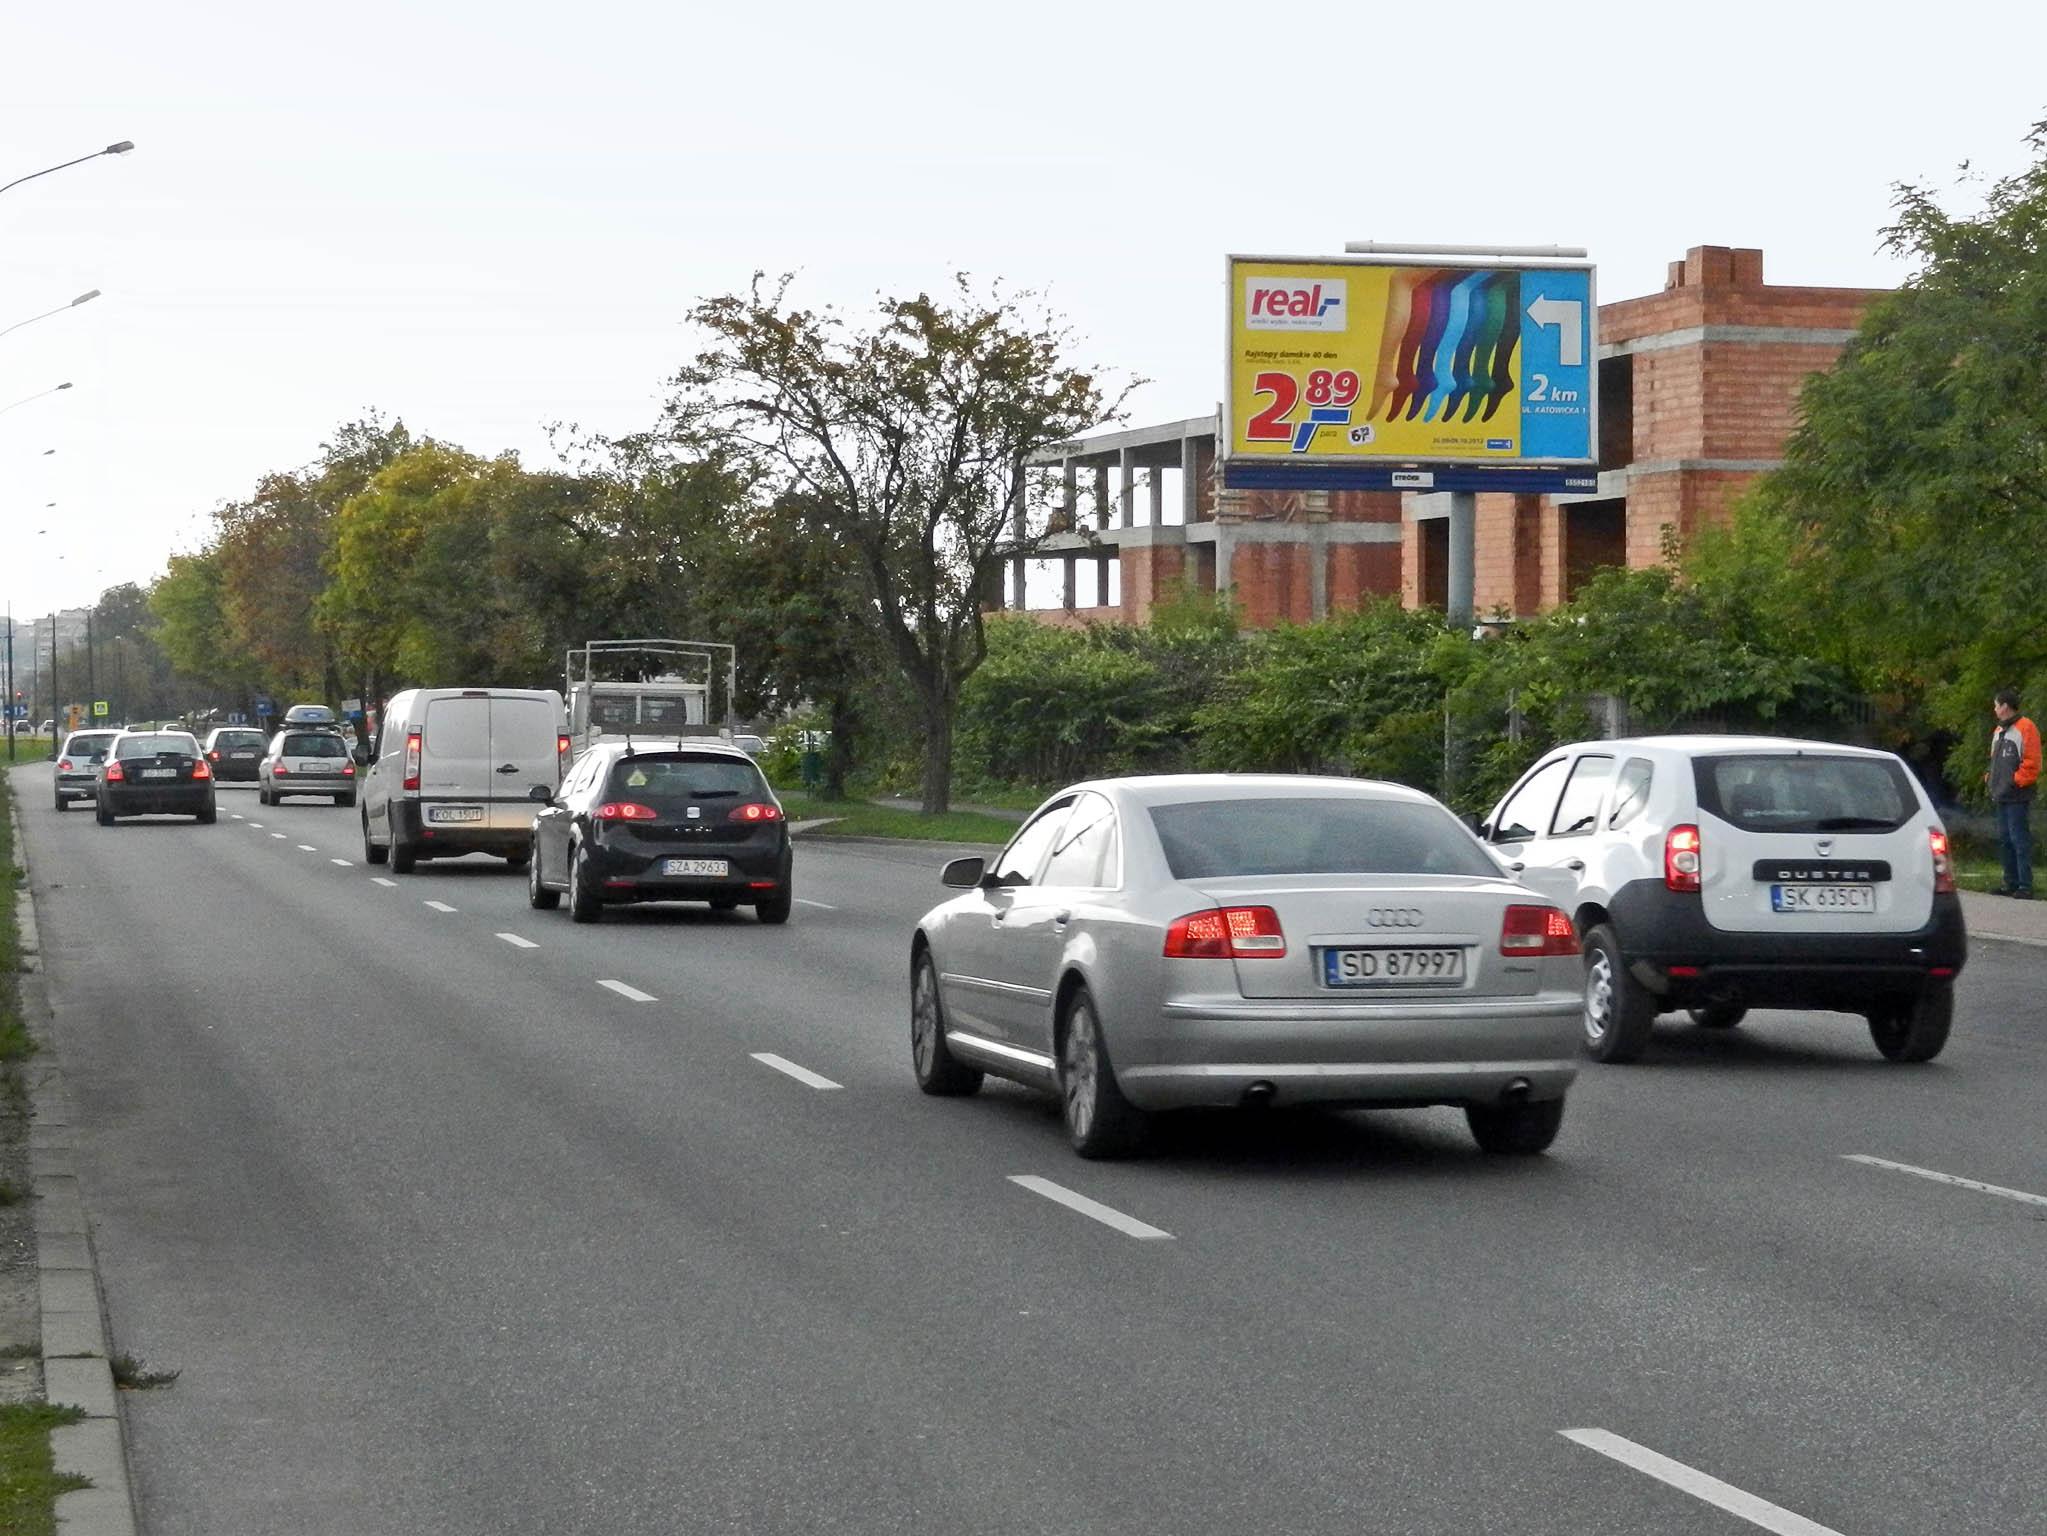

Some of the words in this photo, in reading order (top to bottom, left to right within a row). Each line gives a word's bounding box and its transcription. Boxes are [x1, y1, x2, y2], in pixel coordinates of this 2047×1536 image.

[1528, 373, 1549, 401] 2
[1551, 387, 1578, 402] km
[670, 861, 690, 873] SZA
[694, 861, 728, 873] 29633
[1778, 871, 1870, 879] DUSTER
[1785, 888, 1811, 906] SK
[1817, 888, 1870, 906] 635CY
[1343, 952, 1378, 977] SD
[1385, 952, 1460, 976] 87997
